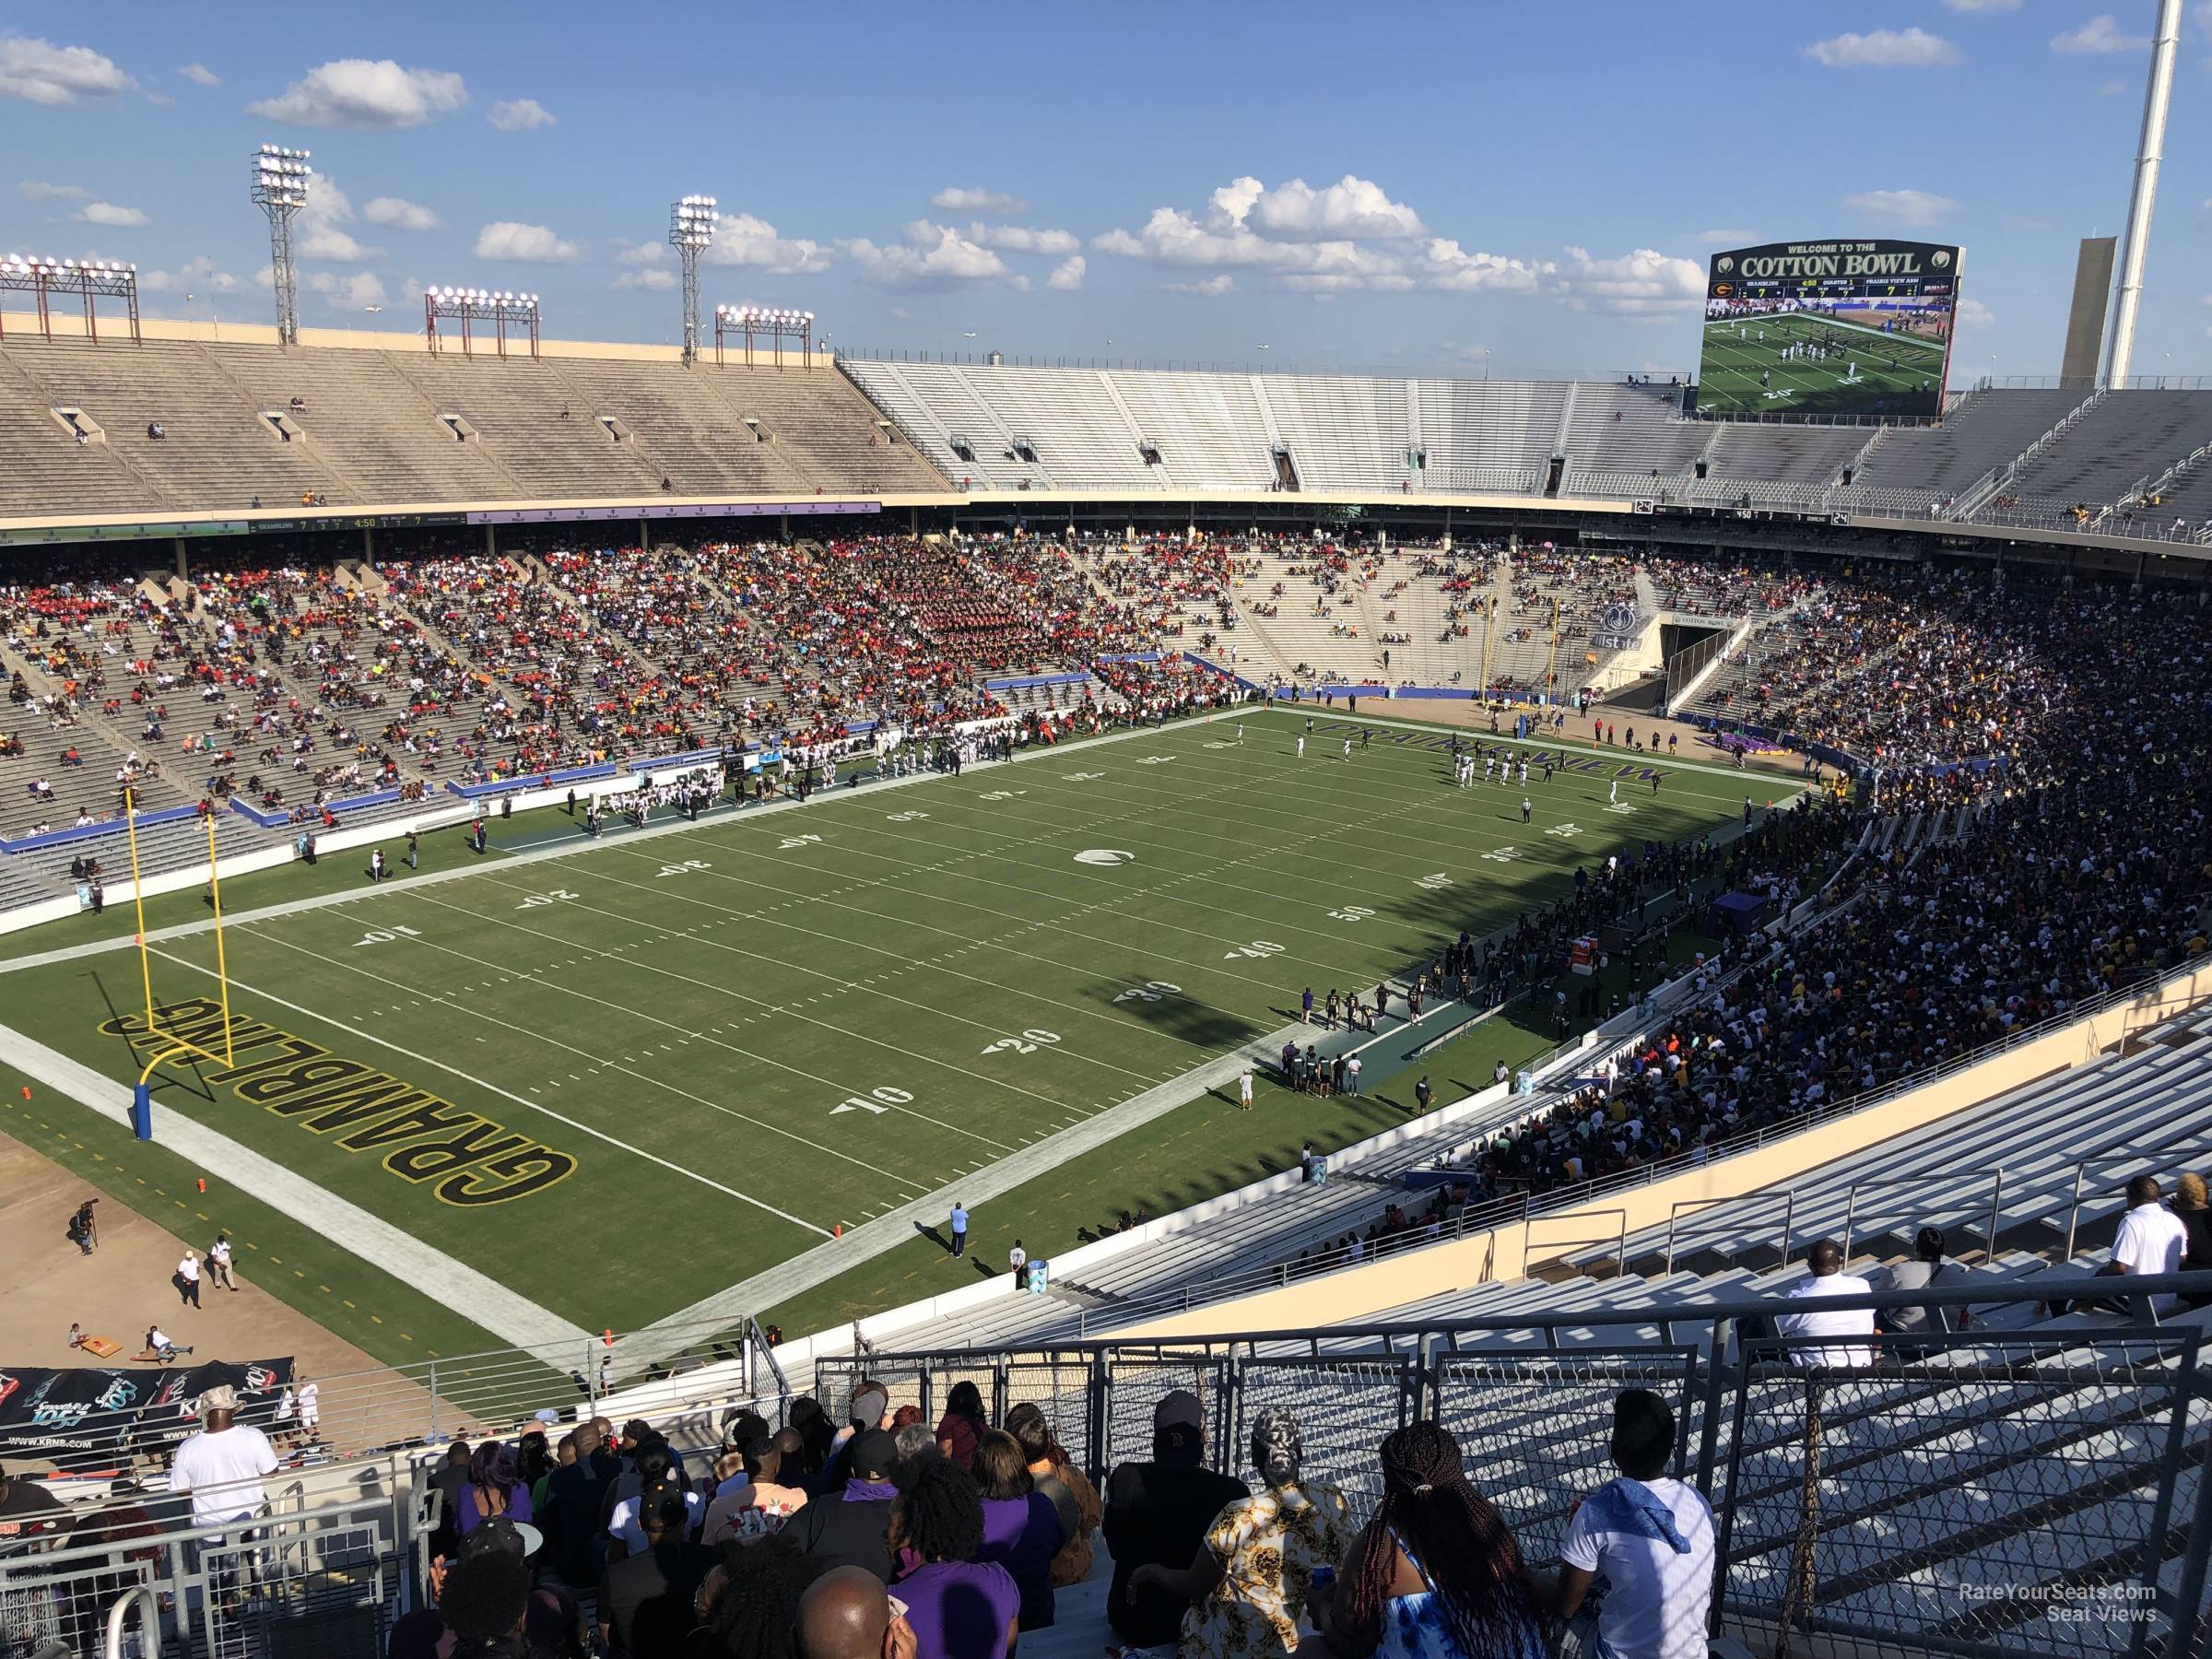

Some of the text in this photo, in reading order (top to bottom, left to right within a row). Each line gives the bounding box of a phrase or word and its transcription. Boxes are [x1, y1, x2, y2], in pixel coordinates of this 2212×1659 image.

[1788, 242, 1876, 253] WELCOME TO THE
[1741, 253, 1922, 277] COTTON BOWL
[1759, 288, 1766, 298] 7
[1888, 287, 1895, 296] 7
[1637, 502, 1652, 512] 24
[354, 518, 376, 528] 4:50
[415, 516, 421, 525] 7
[1833, 512, 1848, 524] 24
[300, 521, 307, 530] 7
[887, 810, 930, 822] 50
[782, 834, 823, 848] 40
[1479, 848, 1523, 862] 30
[660, 859, 712, 876] 30
[1412, 876, 1454, 889] 40
[524, 888, 581, 907] 20
[1326, 905, 1377, 923] 50
[363, 924, 422, 943] 10
[1238, 939, 1287, 959] 40
[1127, 980, 1183, 1004] 30
[996, 1028, 1062, 1055] 20
[97, 996, 580, 1207] GRAMBLING
[842, 1086, 914, 1116] 10
[36, 1401, 73, 1411] Smooth
[8, 1437, 92, 1449] WWW.KRNB.COM
